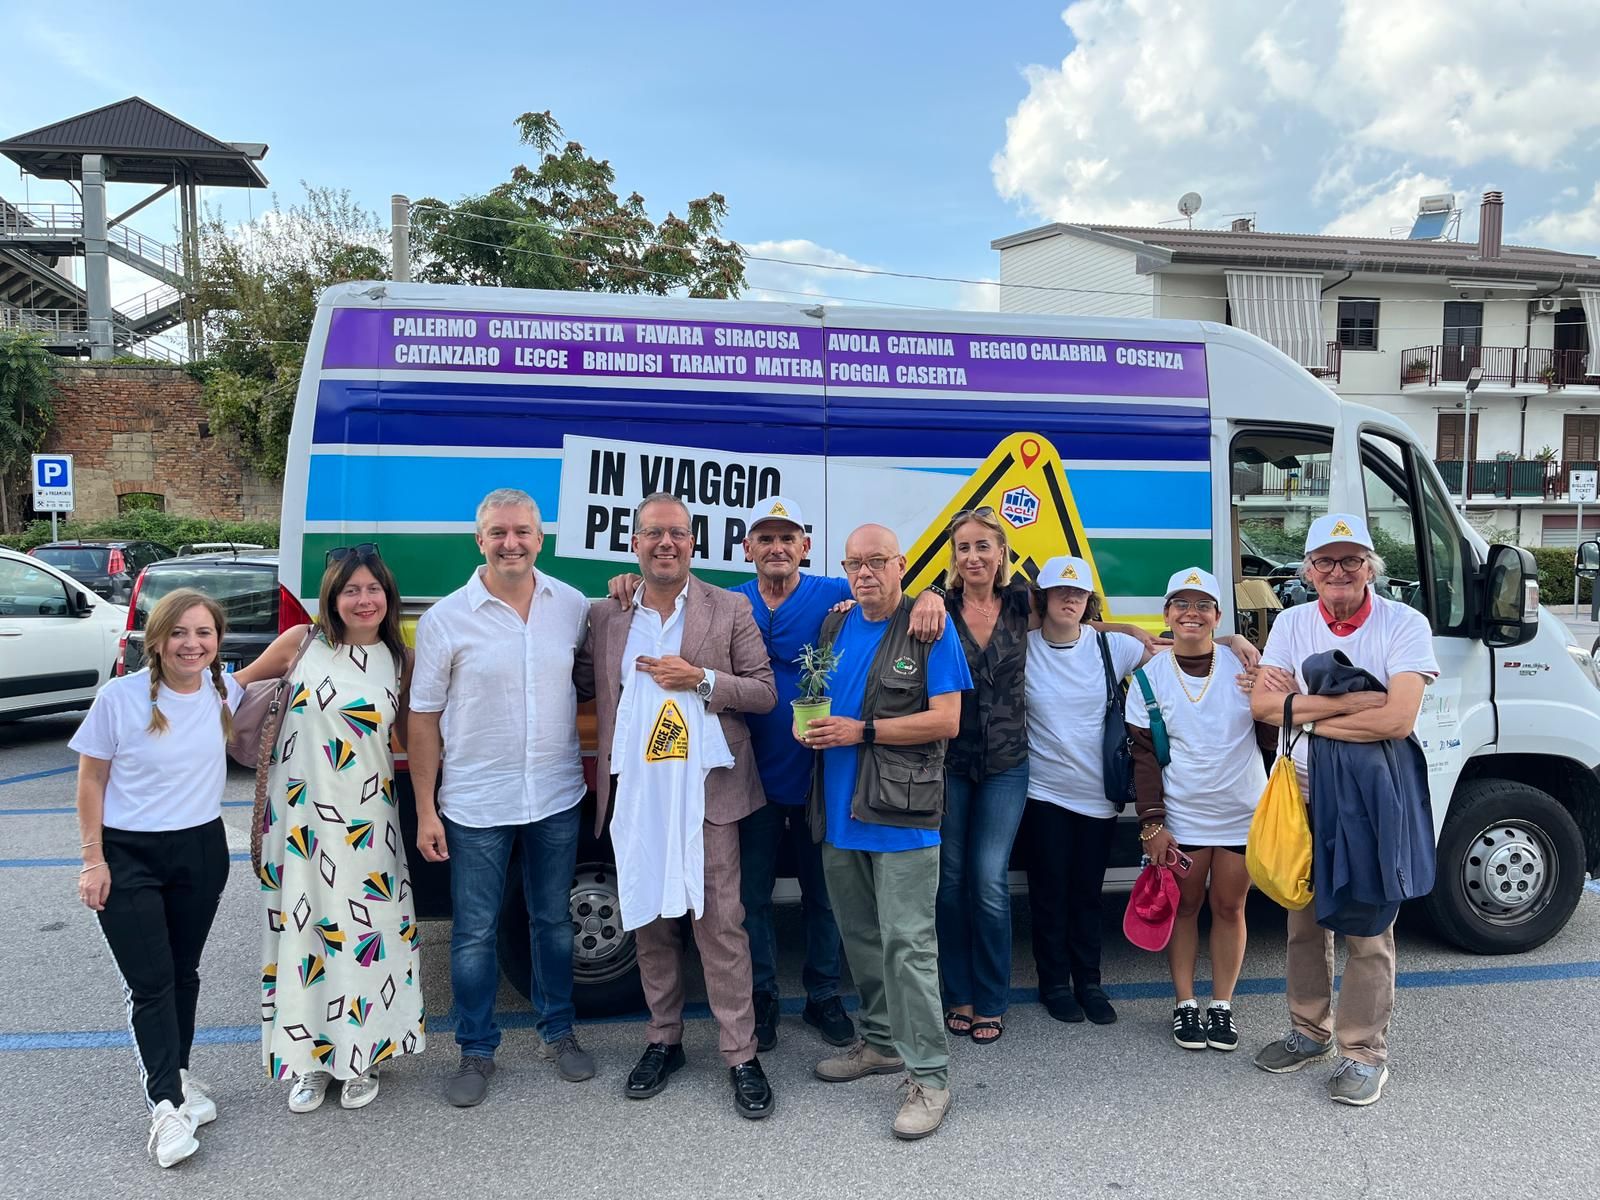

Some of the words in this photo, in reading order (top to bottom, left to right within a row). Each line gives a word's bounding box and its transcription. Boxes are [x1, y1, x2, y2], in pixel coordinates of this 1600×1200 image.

[393, 317, 477, 338] PALERMO
[488, 319, 625, 343] CALTANISSETTA
[635, 324, 704, 346] FAVARA
[714, 327, 800, 350] SIRACUSA
[828, 333, 880, 353] AVOLA
[887, 336, 955, 356] CATANIA
[969, 341, 1027, 360] REGGIO
[1030, 342, 1107, 362] CALABRIA
[1115, 347, 1184, 371] COSENZA
[395, 344, 500, 366] CATANZARO
[514, 347, 568, 369] LECCE
[582, 350, 663, 374] BRINDISI
[670, 354, 747, 375] TARANTO
[755, 356, 824, 378] MATERA
[830, 362, 890, 383] FOGGIA
[896, 365, 968, 386] CASERTA
[44, 463, 62, 484] P
[588, 449, 626, 497] IN
[640, 454, 781, 509] VIAGGIO
[1005, 505, 1034, 517] ACLI
[652, 729, 669, 756] PEACE
[661, 717, 672, 730] AT
